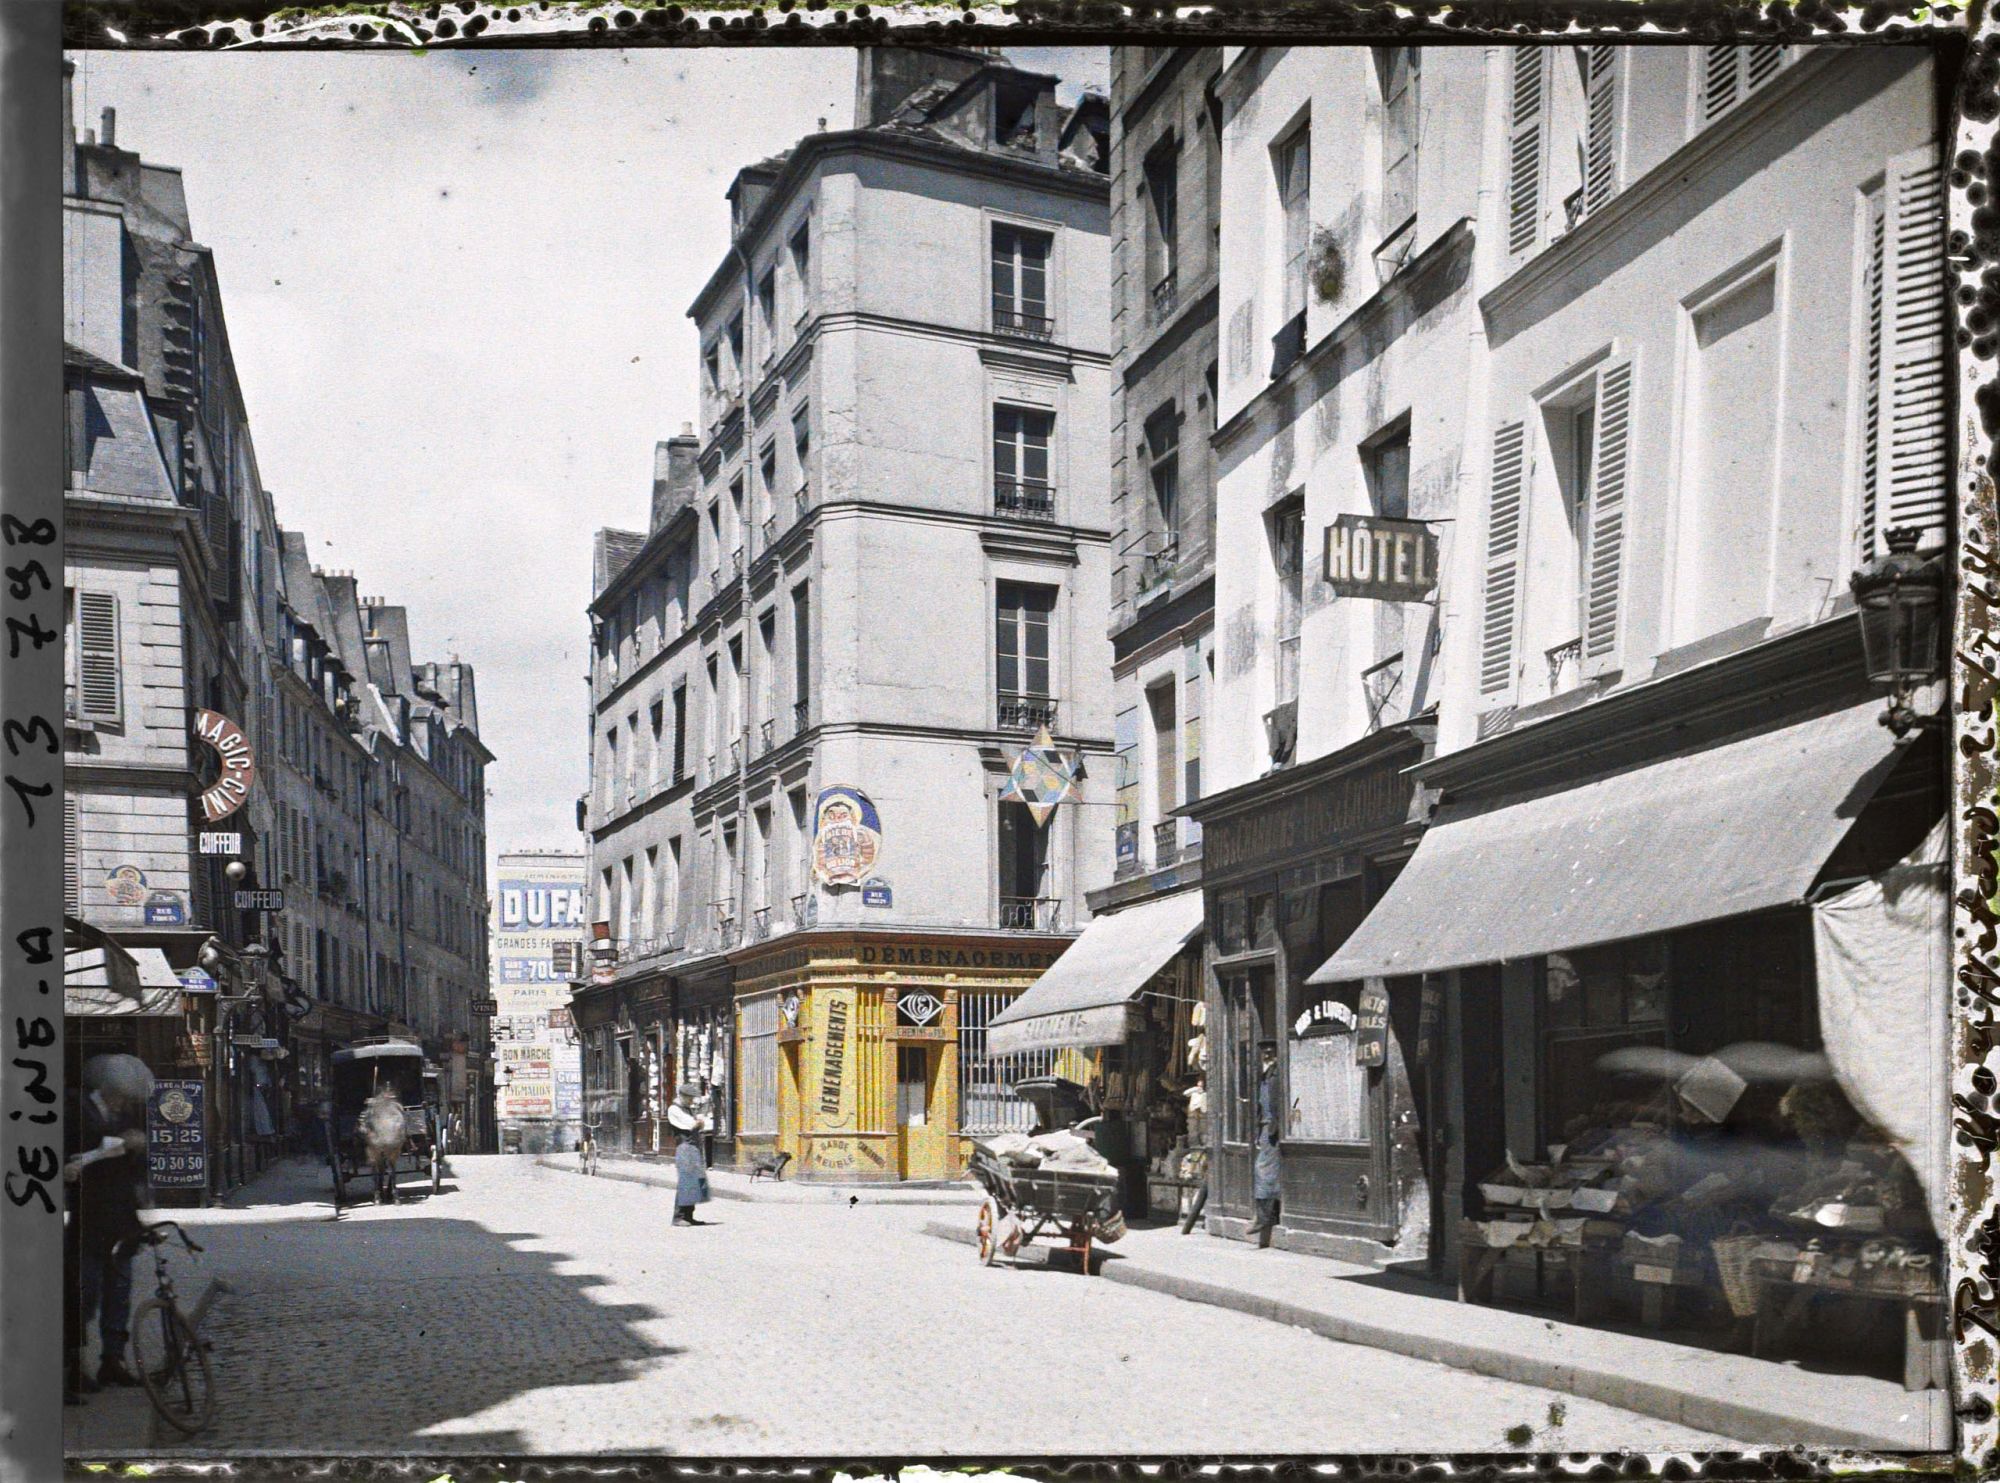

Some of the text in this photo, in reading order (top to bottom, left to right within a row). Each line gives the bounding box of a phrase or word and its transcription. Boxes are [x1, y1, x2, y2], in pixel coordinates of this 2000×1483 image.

[1328, 519, 1433, 586] HÔTEL
[200, 832, 241, 855] COIFFEUR
[234, 890, 282, 909] COIFFEUR
[497, 938, 537, 949] GRANDES
[514, 989, 547, 997] PARIS
[503, 1048, 519, 1061] BON
[151, 1129, 202, 1144] 15 25
[150, 1156, 203, 1170] 20 30 50
